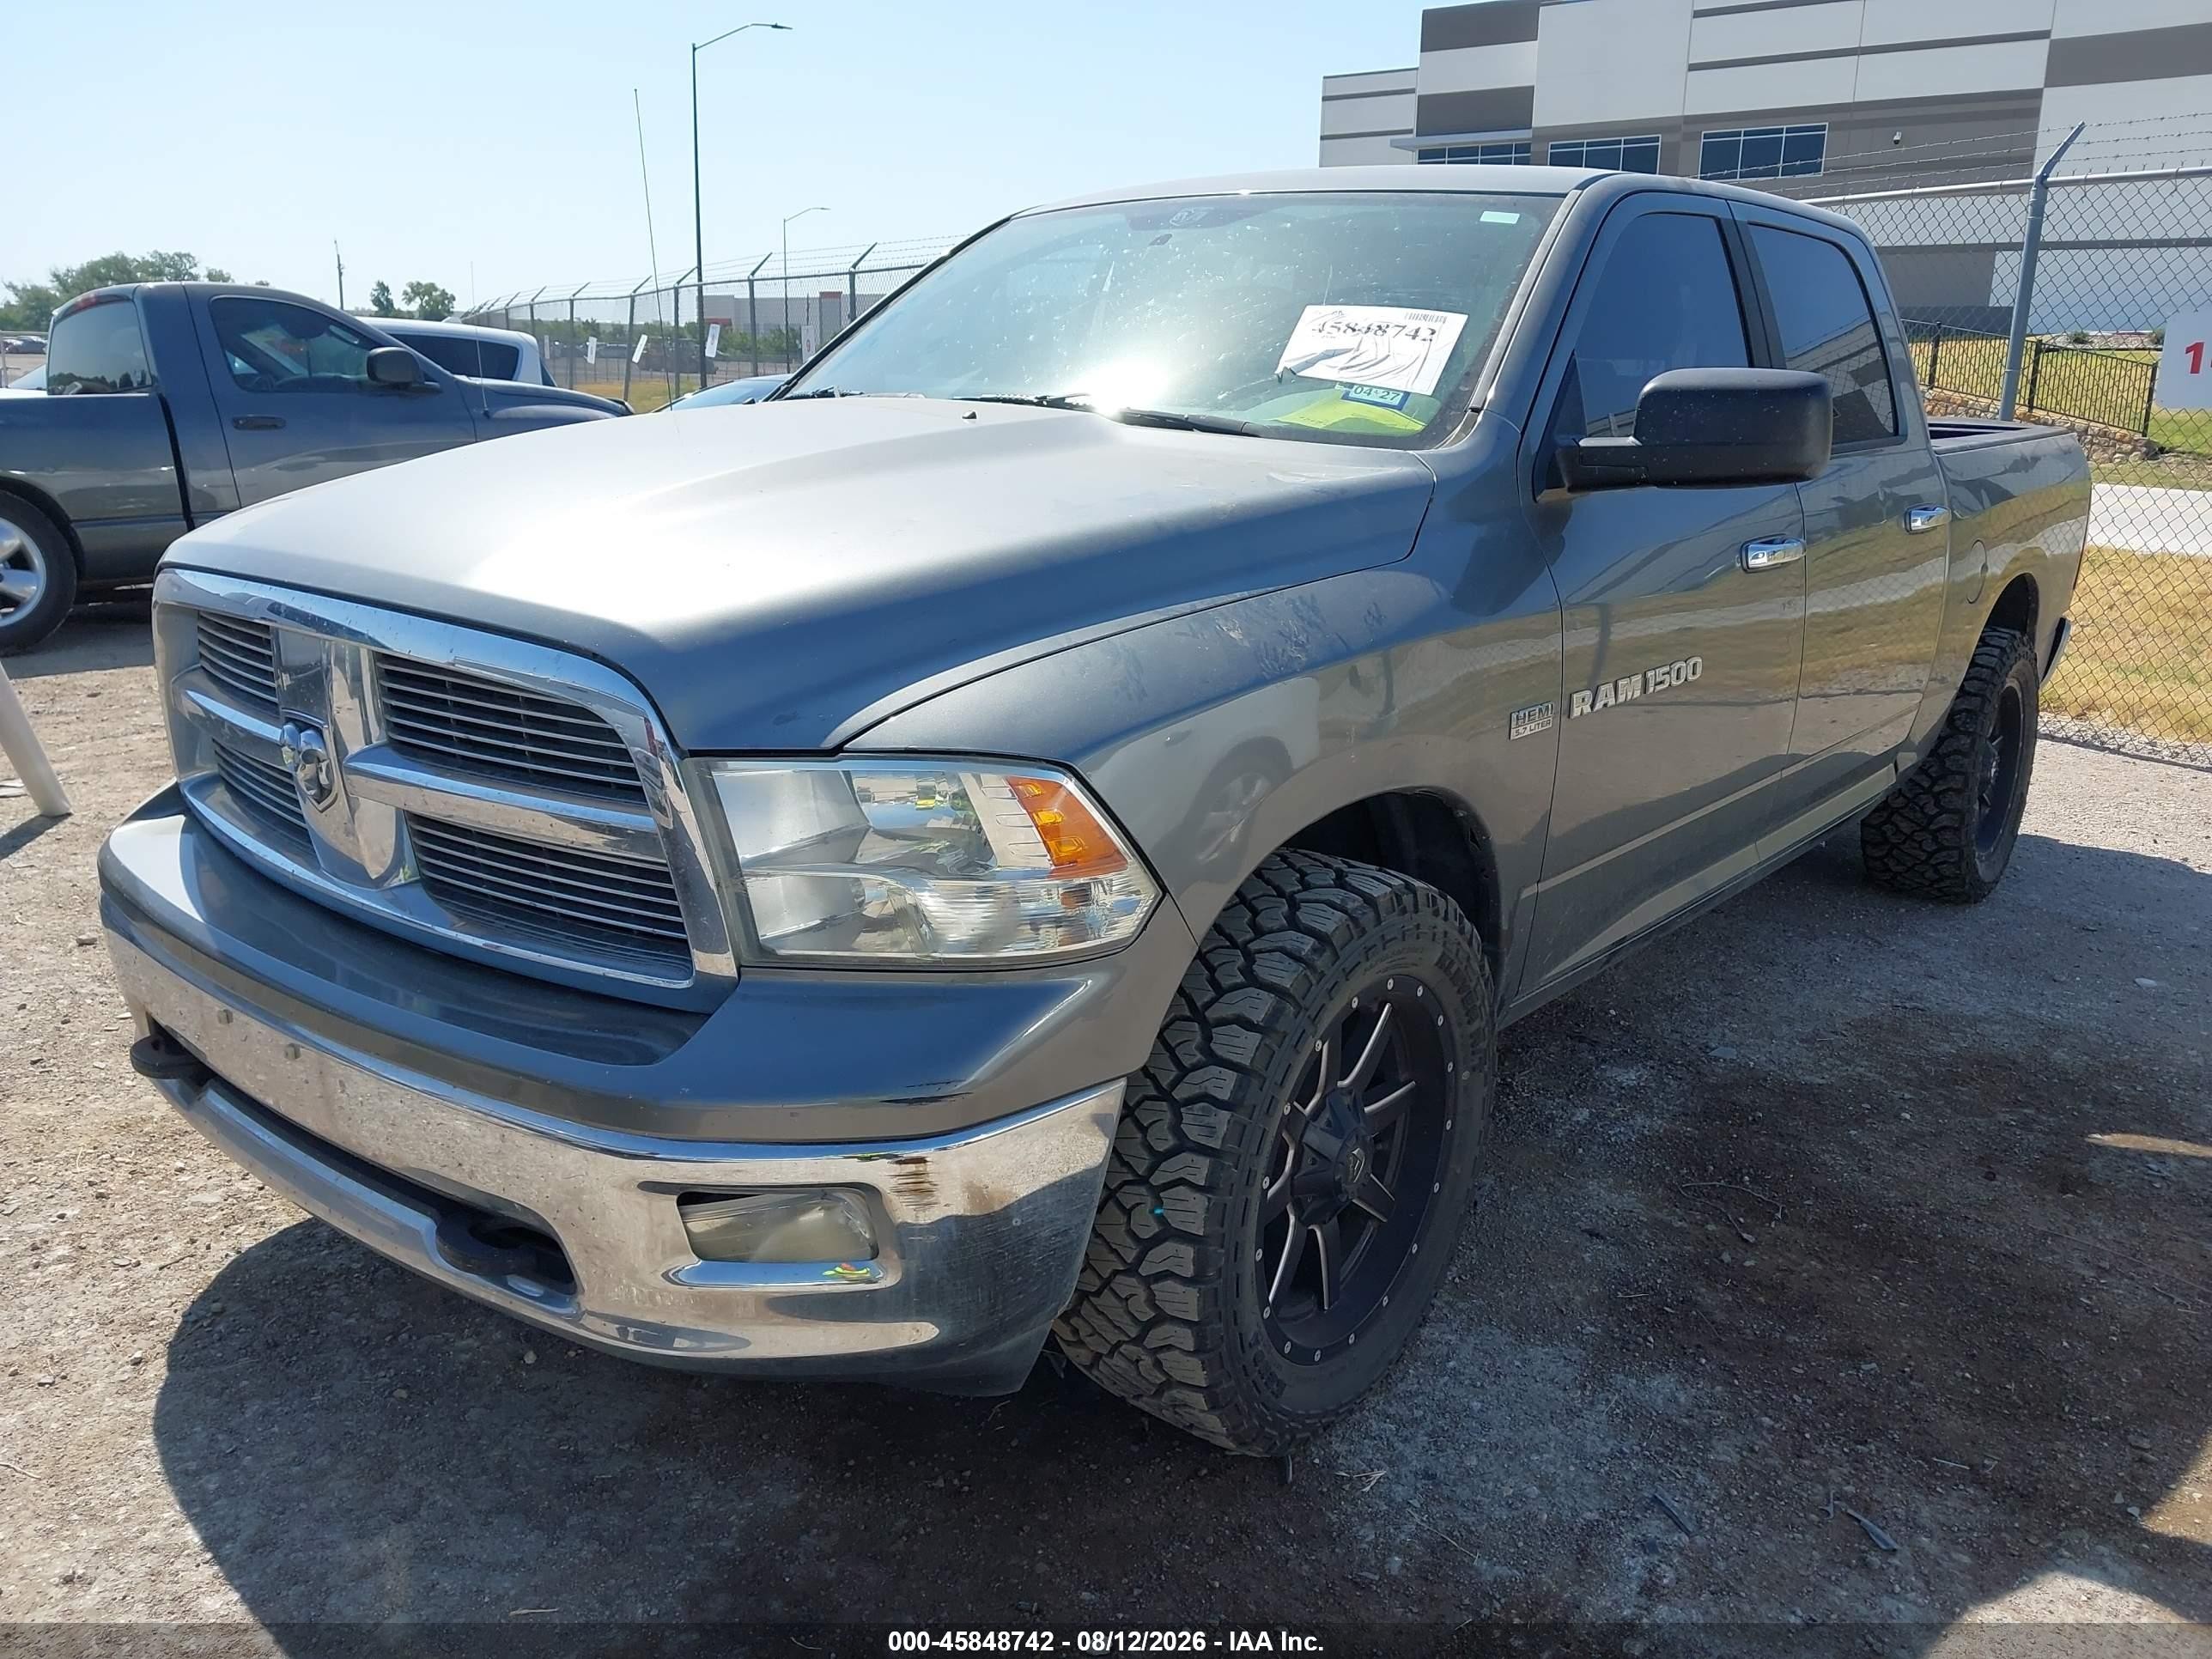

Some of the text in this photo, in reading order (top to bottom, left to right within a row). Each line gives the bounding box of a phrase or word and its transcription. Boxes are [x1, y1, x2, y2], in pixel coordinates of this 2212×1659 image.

[1570, 656, 1703, 720] RAM 1500
[1515, 702, 1554, 726] HEMI
[1529, 718, 1553, 732] LITER
